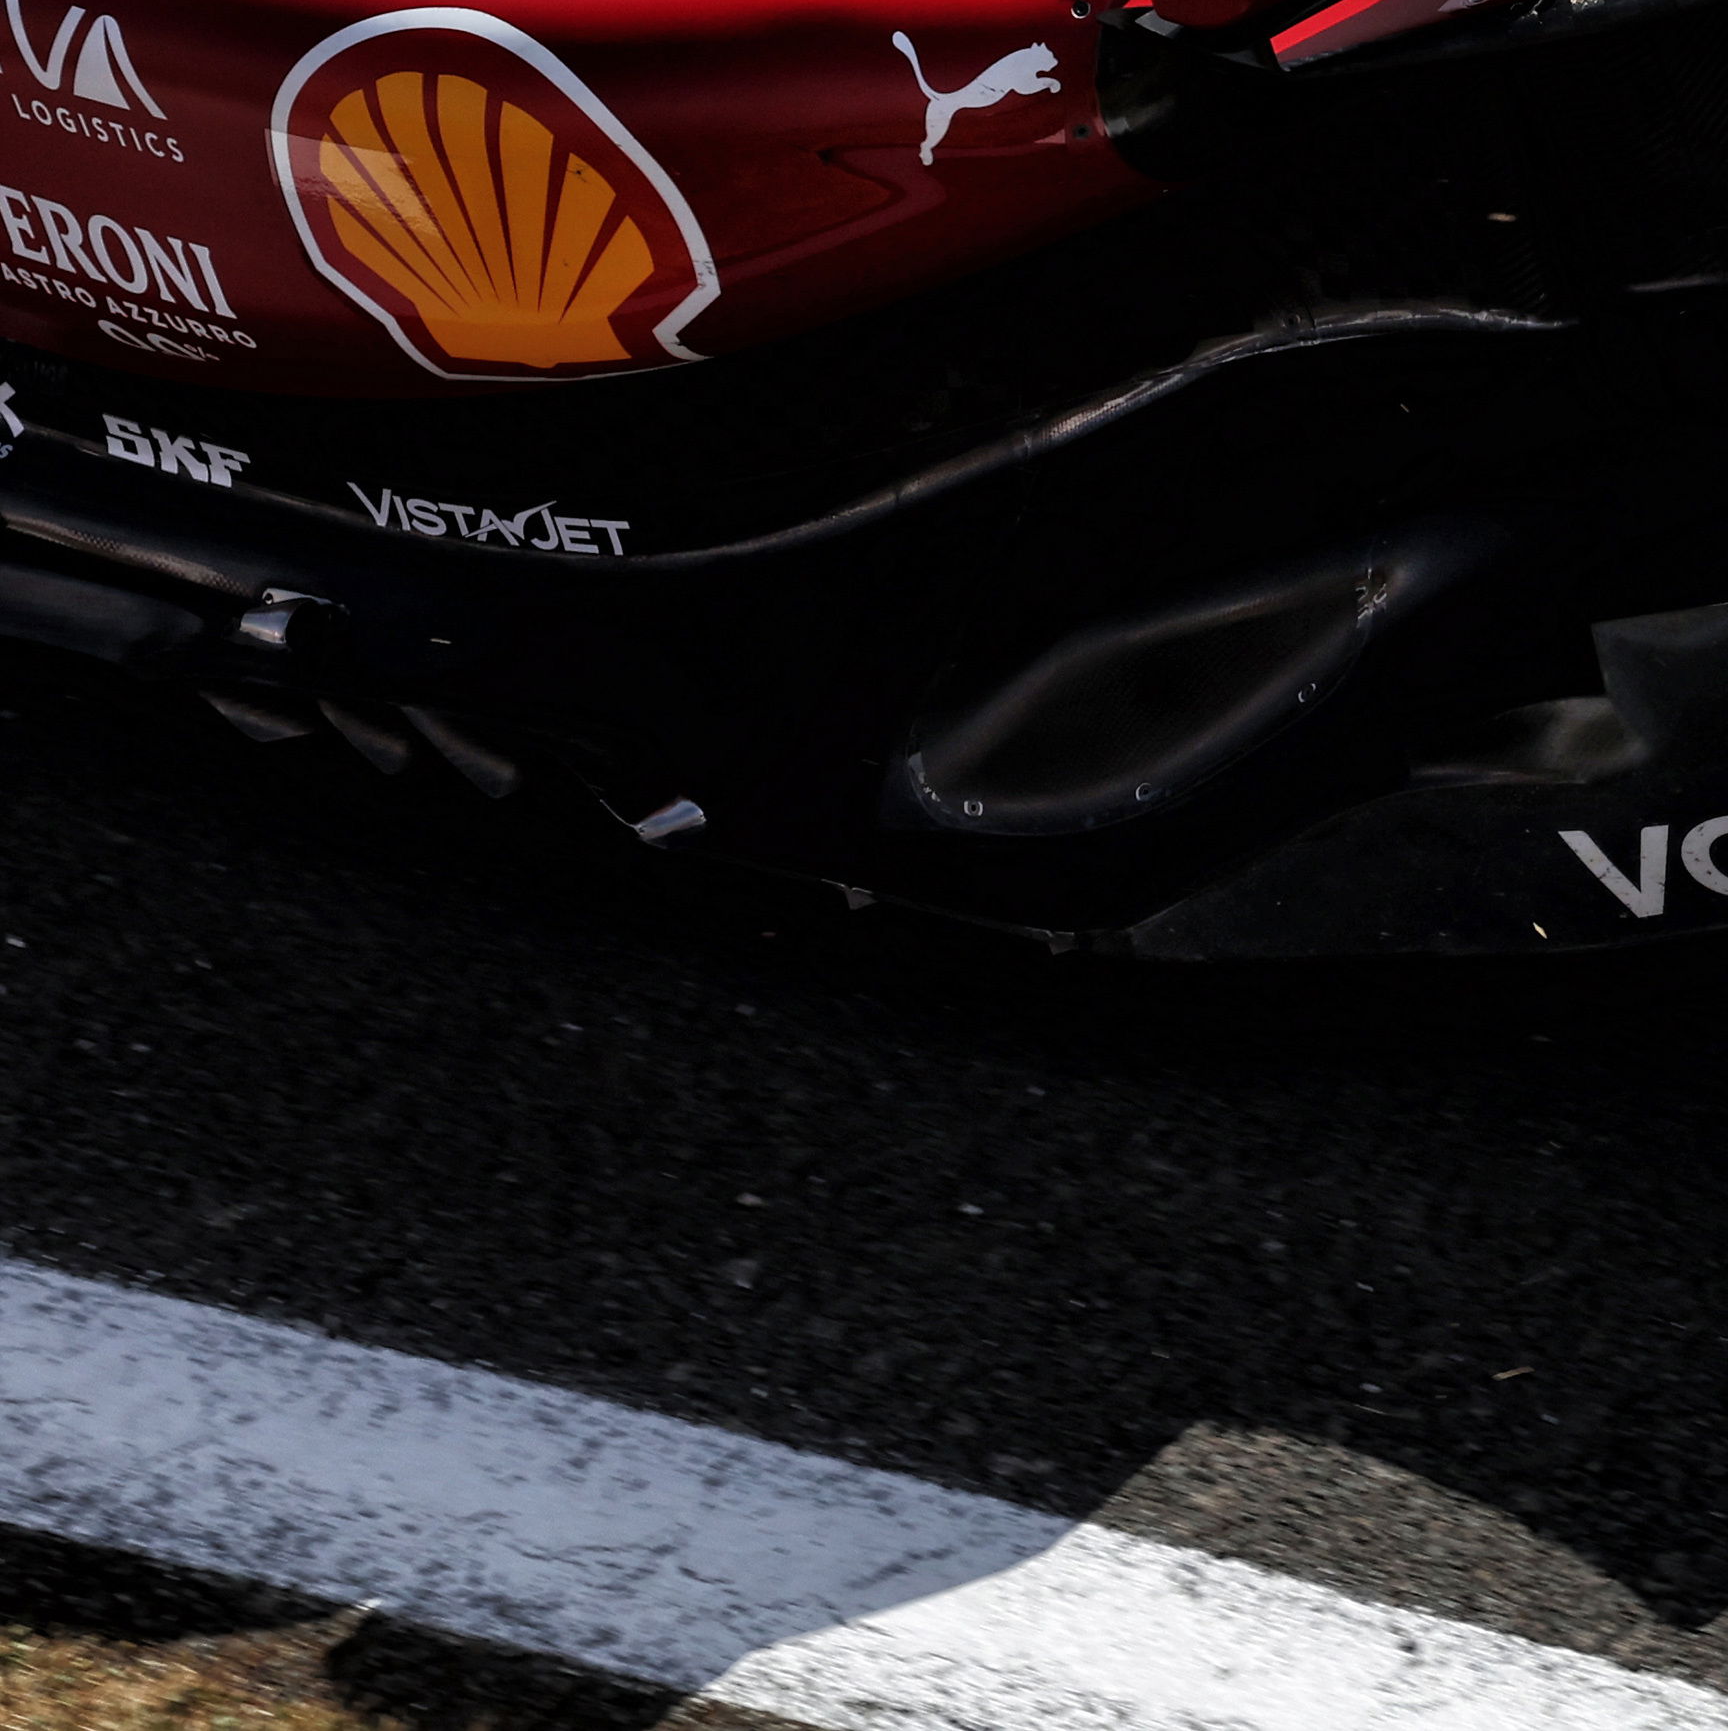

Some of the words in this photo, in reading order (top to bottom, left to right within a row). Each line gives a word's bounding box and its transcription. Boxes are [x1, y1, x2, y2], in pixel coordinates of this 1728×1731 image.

[12, 93, 185, 164] LOGISTICS
[105, 295, 258, 349] AZZURRO
[102, 413, 251, 488] SKF
[346, 481, 630, 557] VISTAJET
